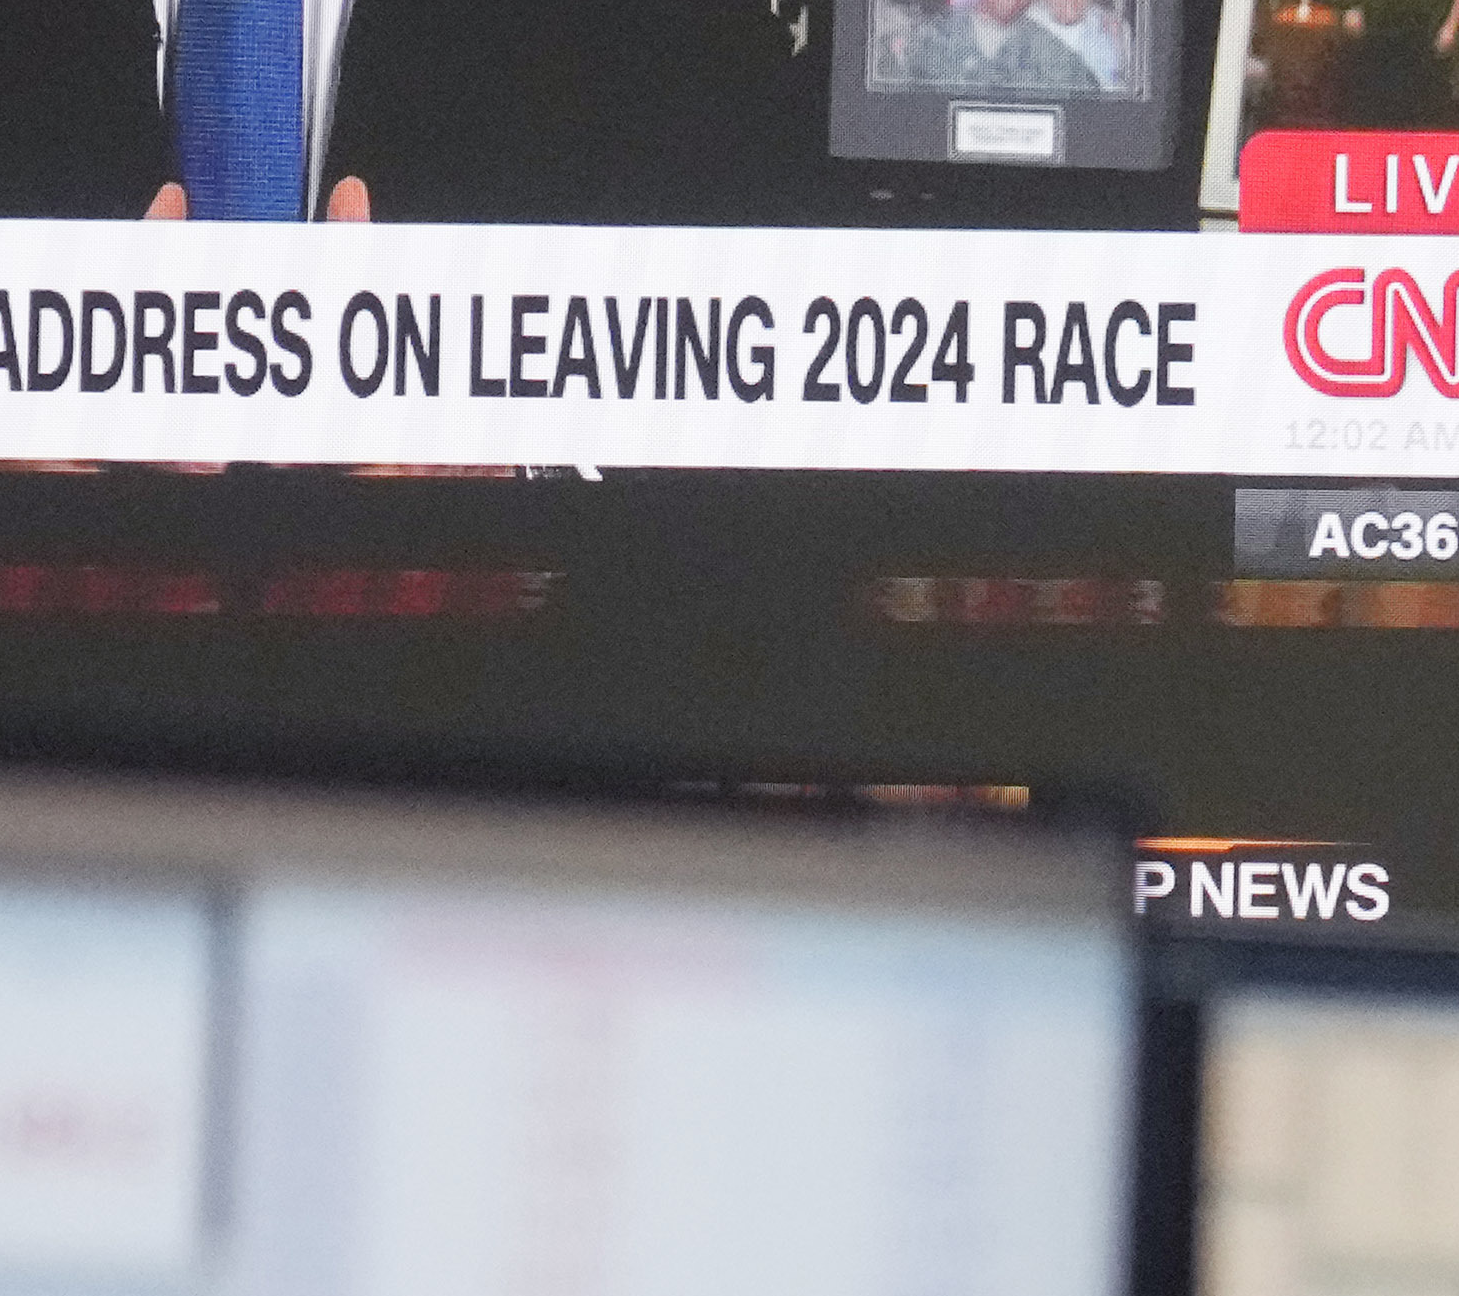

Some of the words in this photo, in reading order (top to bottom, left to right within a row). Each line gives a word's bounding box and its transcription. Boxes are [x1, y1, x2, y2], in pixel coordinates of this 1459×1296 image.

[338, 290, 442, 400] ON
[469, 294, 776, 404] LEAVING
[801, 296, 976, 405] 2024
[1001, 300, 1197, 408] RACE
[1283, 418, 1388, 452] 12:02
[1189, 860, 1391, 922] NEWS
